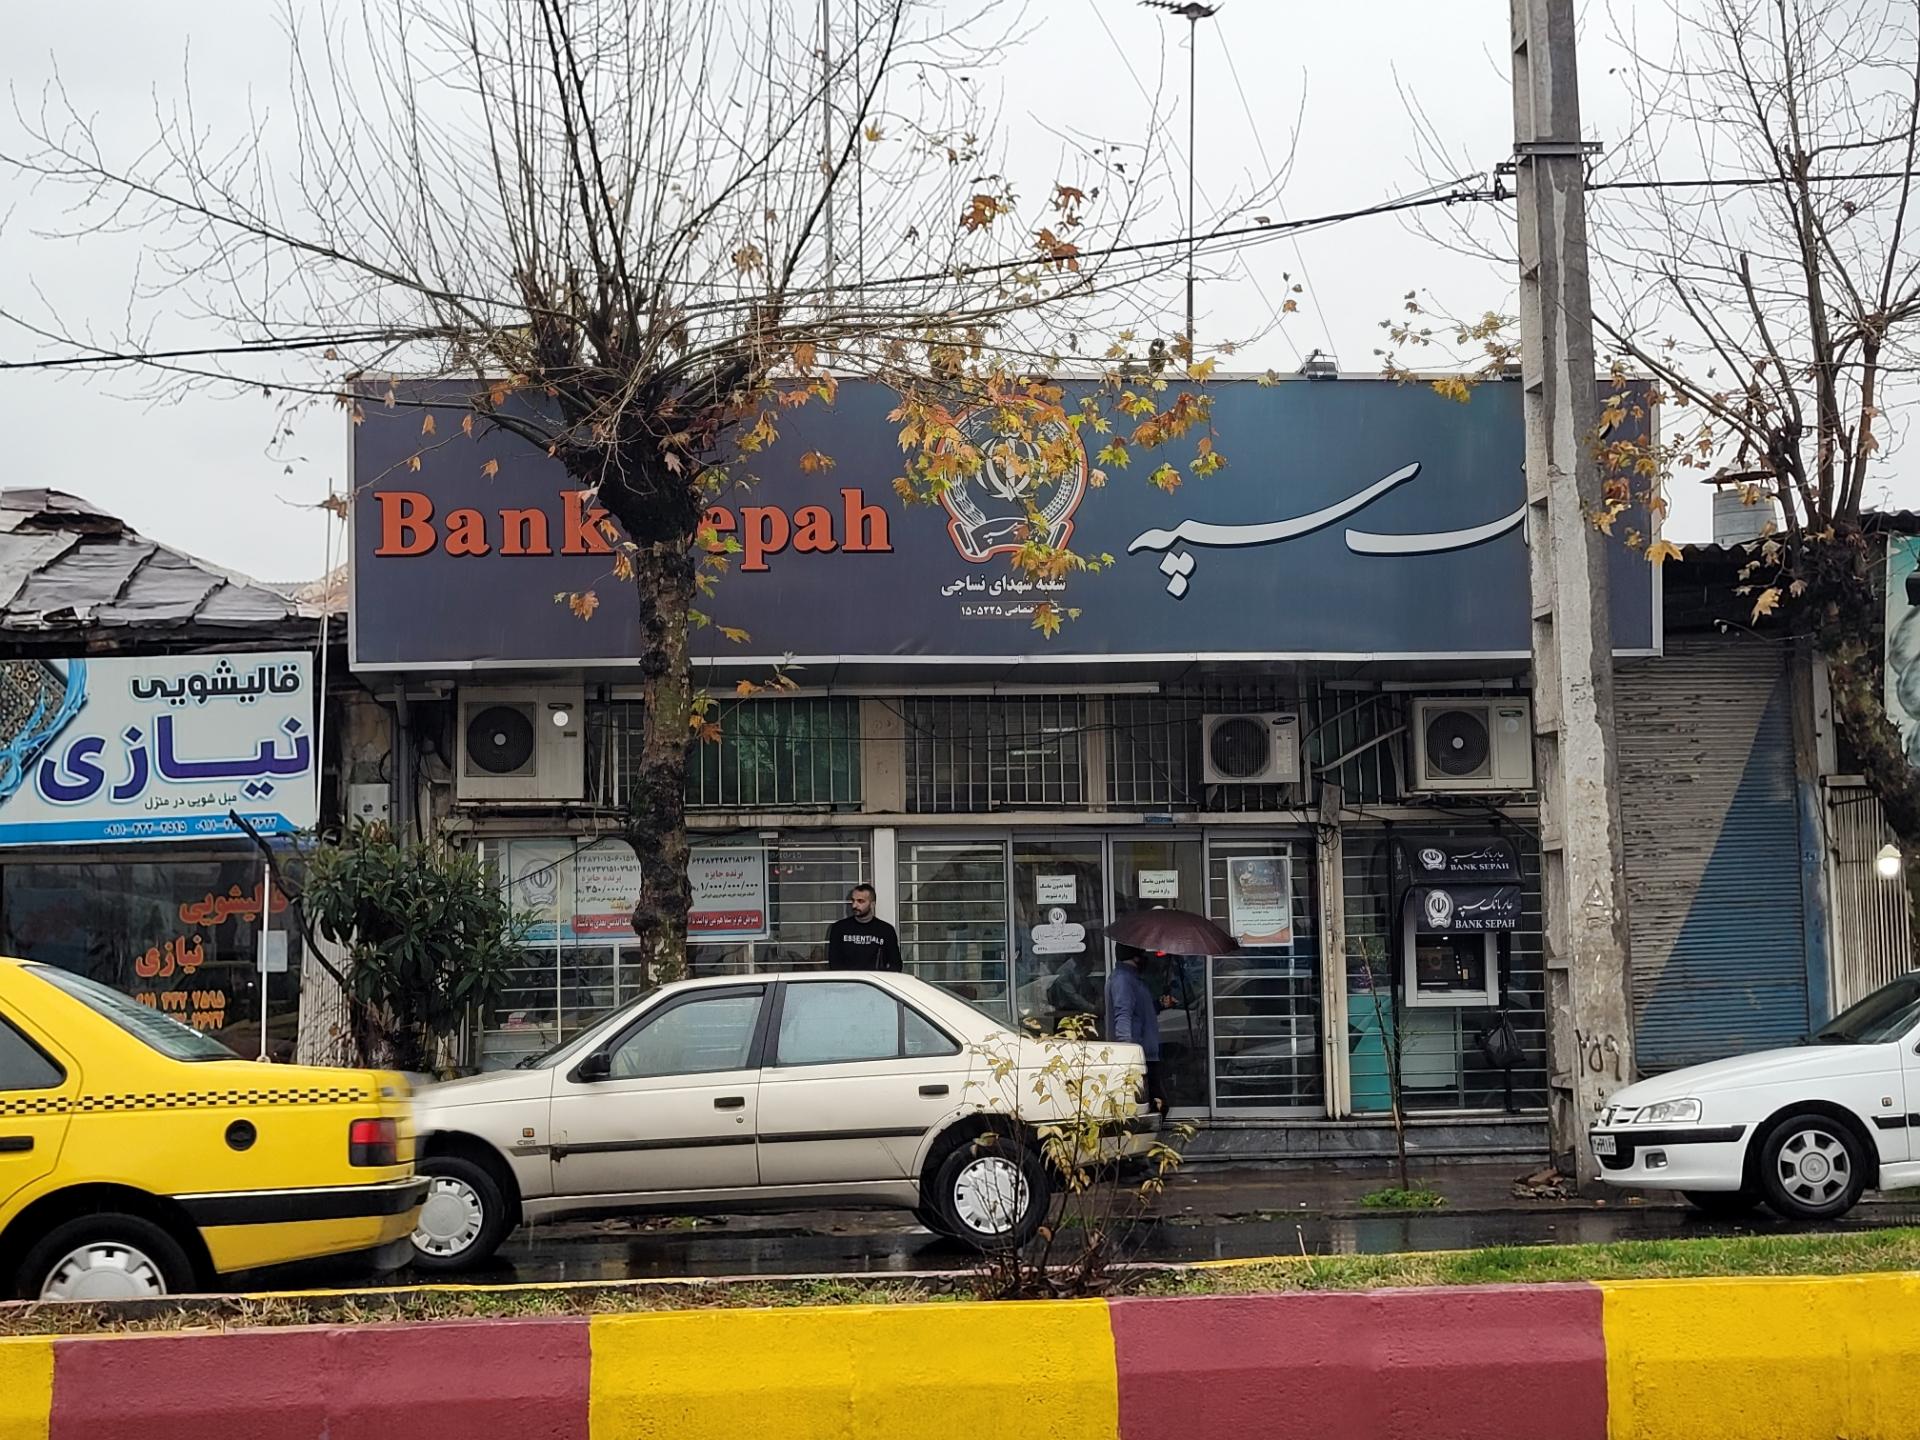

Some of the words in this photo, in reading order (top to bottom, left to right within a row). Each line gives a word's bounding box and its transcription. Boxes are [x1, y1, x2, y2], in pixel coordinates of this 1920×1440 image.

[374, 488, 614, 557] Bank
[697, 487, 894, 572] epah
[941, 575, 986, 597] نساجی
[1036, 575, 1067, 595] شعبه
[133, 659, 301, 706] قالیشویی
[39, 714, 311, 803] نیازی
[144, 796, 170, 811] منزل
[173, 796, 185, 809] در
[188, 793, 216, 808] شویی
[218, 792, 238, 807] مبل
[704, 869, 724, 880] جایزه
[1450, 863, 1477, 871] BANK
[1479, 862, 1510, 871] SEPAH
[178, 881, 289, 927] قلیشویی
[1457, 898, 1487, 918] سپه
[1479, 887, 1504, 917] بانک
[1500, 898, 1513, 918] عابر
[1455, 919, 1483, 929] BANK
[1485, 919, 1516, 929] SEPAH
[843, 934, 885, 946] ESSENTIALS
[135, 934, 205, 978] نیازی
